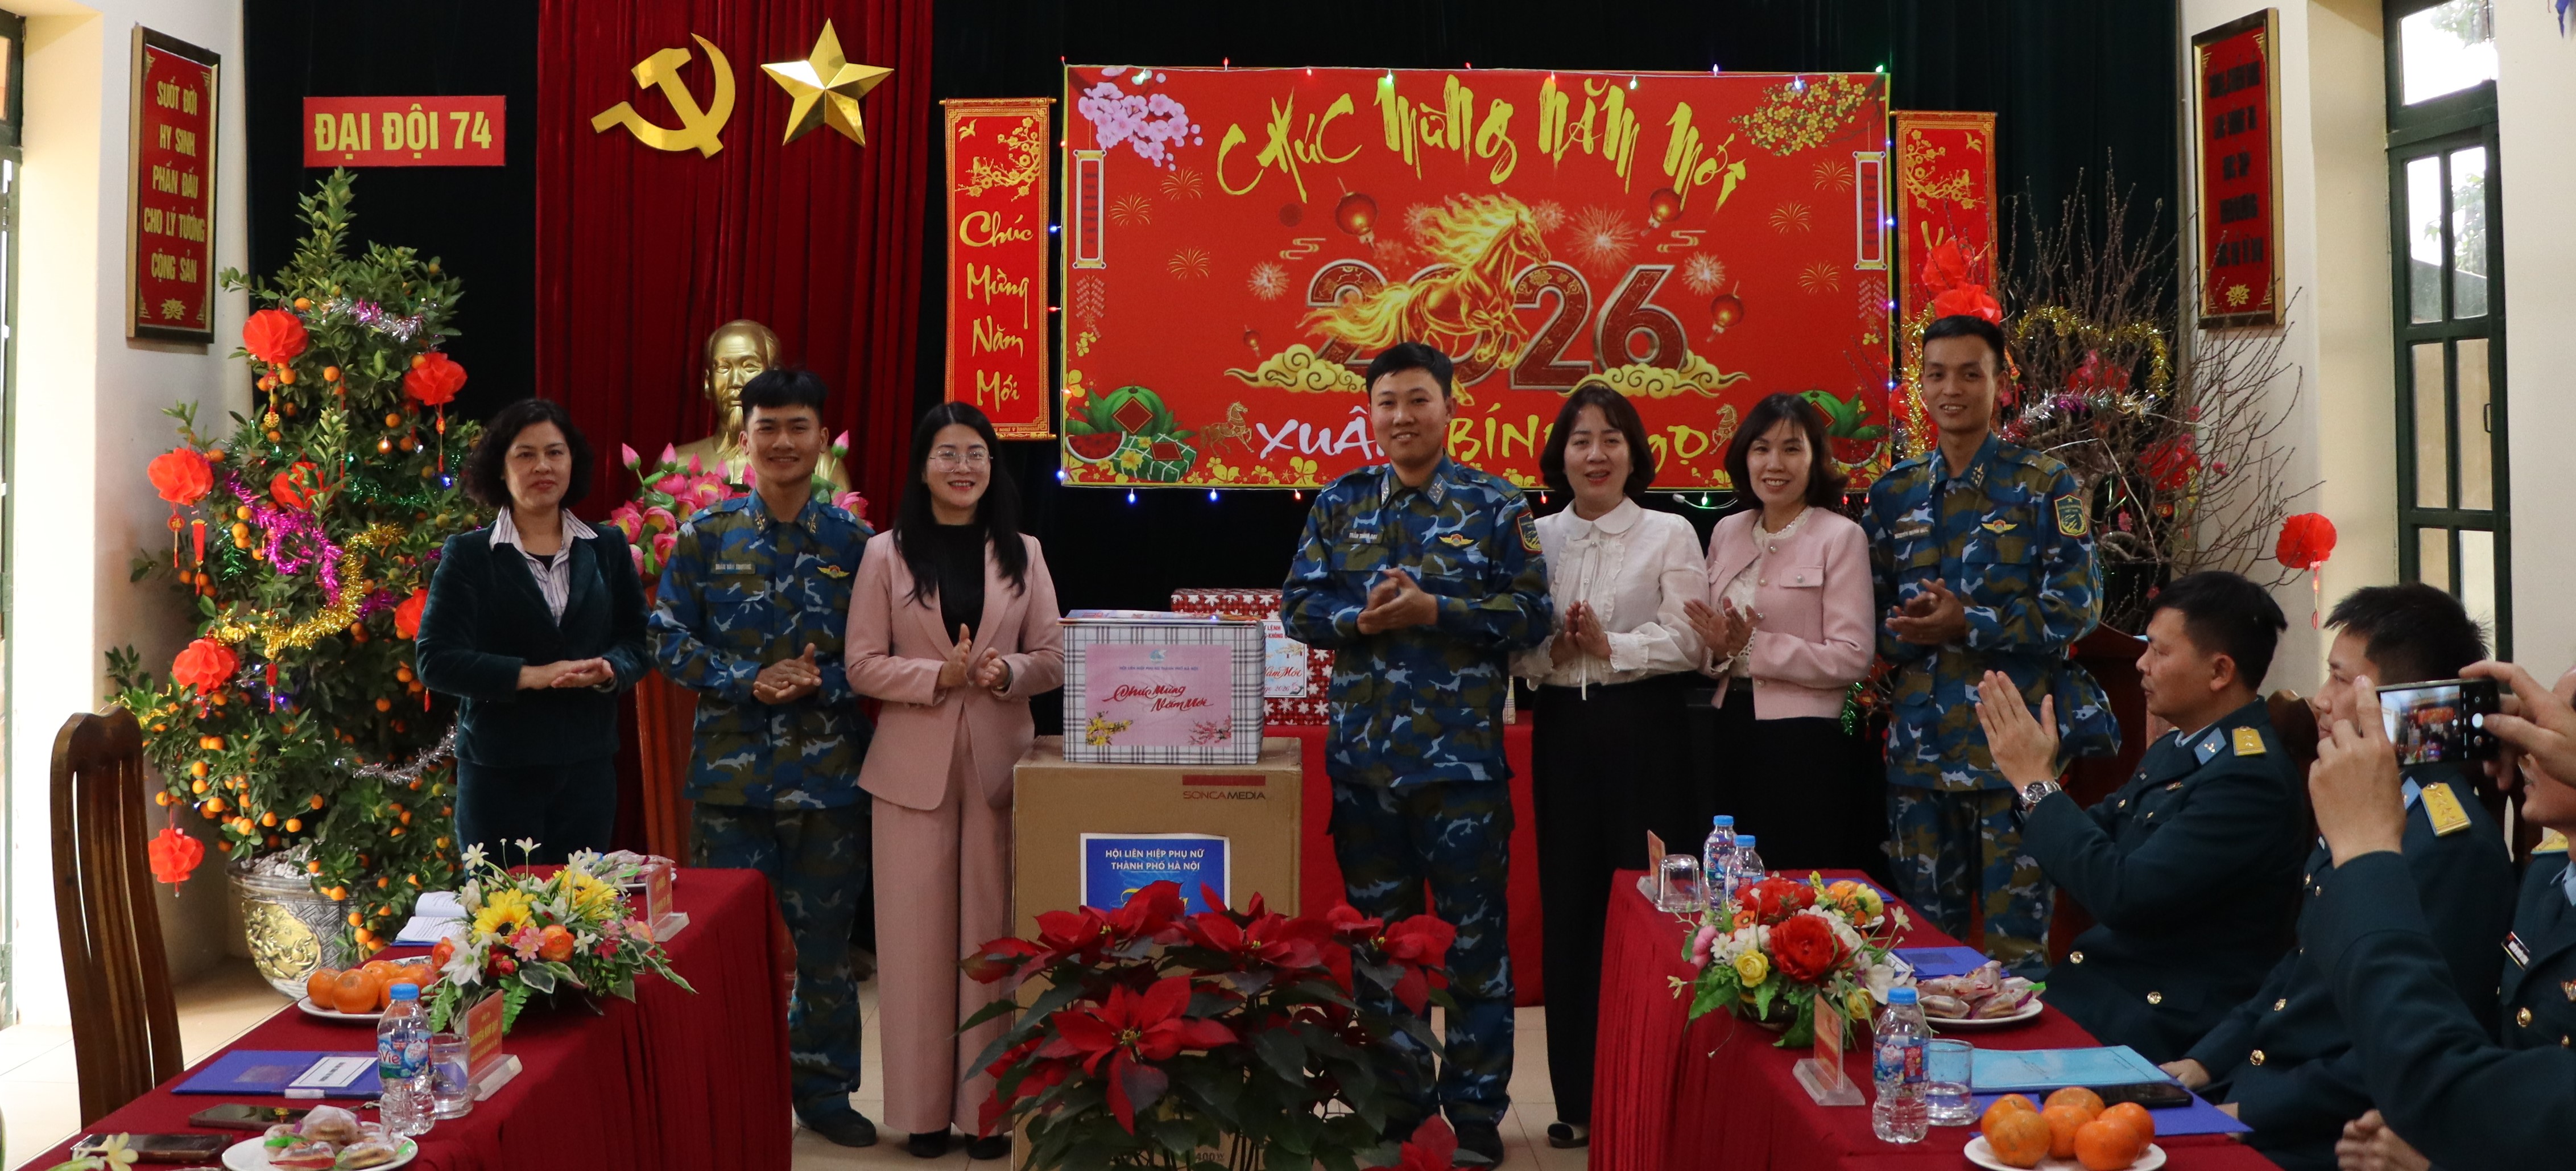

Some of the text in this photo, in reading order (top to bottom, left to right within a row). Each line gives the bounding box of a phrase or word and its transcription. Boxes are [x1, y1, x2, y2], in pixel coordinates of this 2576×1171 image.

[157, 76, 197, 116] SUỐT ĐỜI
[160, 124, 172, 150] HY
[315, 104, 493, 160] ĐẠI ĐỘI 74
[152, 161, 199, 199] PHẤN ĐẤU
[144, 206, 205, 242] CHO LÝ TƯỞNG
[960, 211, 1033, 248] Chúc
[151, 248, 197, 283] CỘNG SẢN
[967, 262, 1030, 329] Mừng
[971, 315, 1024, 358] Năm
[976, 369, 1020, 413] Mới
[1447, 403, 1554, 461] BÍN
[1102, 684, 1186, 702] Chúc Mừng
[1150, 698, 1188, 712] Năm
[1183, 791, 1266, 800] SONCAMEDIA
[1105, 848, 1205, 859] HỘI LIÊN HIỆP PHỤ NỮ
[1111, 860, 1200, 871] THÀNH PHỐ HÀ NỘI
